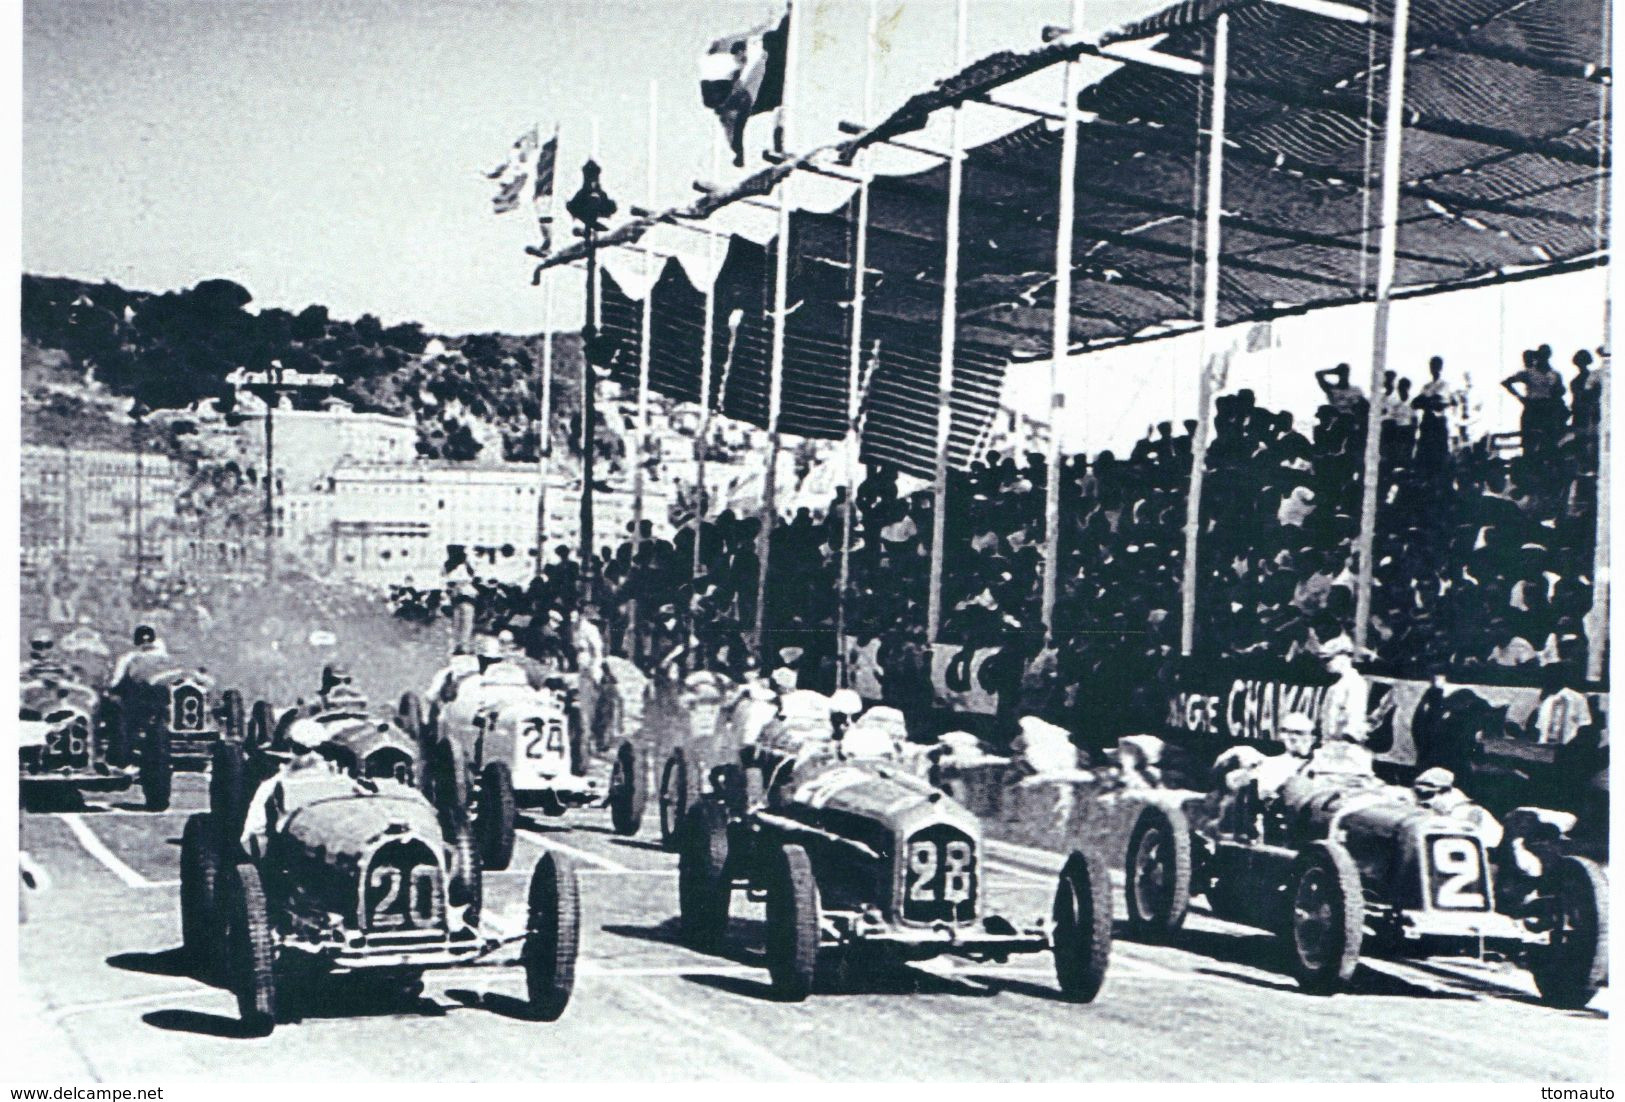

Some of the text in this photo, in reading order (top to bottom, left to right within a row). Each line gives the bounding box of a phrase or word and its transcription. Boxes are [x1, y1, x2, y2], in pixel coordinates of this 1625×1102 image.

[181, 695, 200, 729] 8
[522, 725, 566, 760] 24
[371, 864, 442, 929] 20
[910, 840, 971, 904] 28
[1433, 839, 1486, 907] 2
